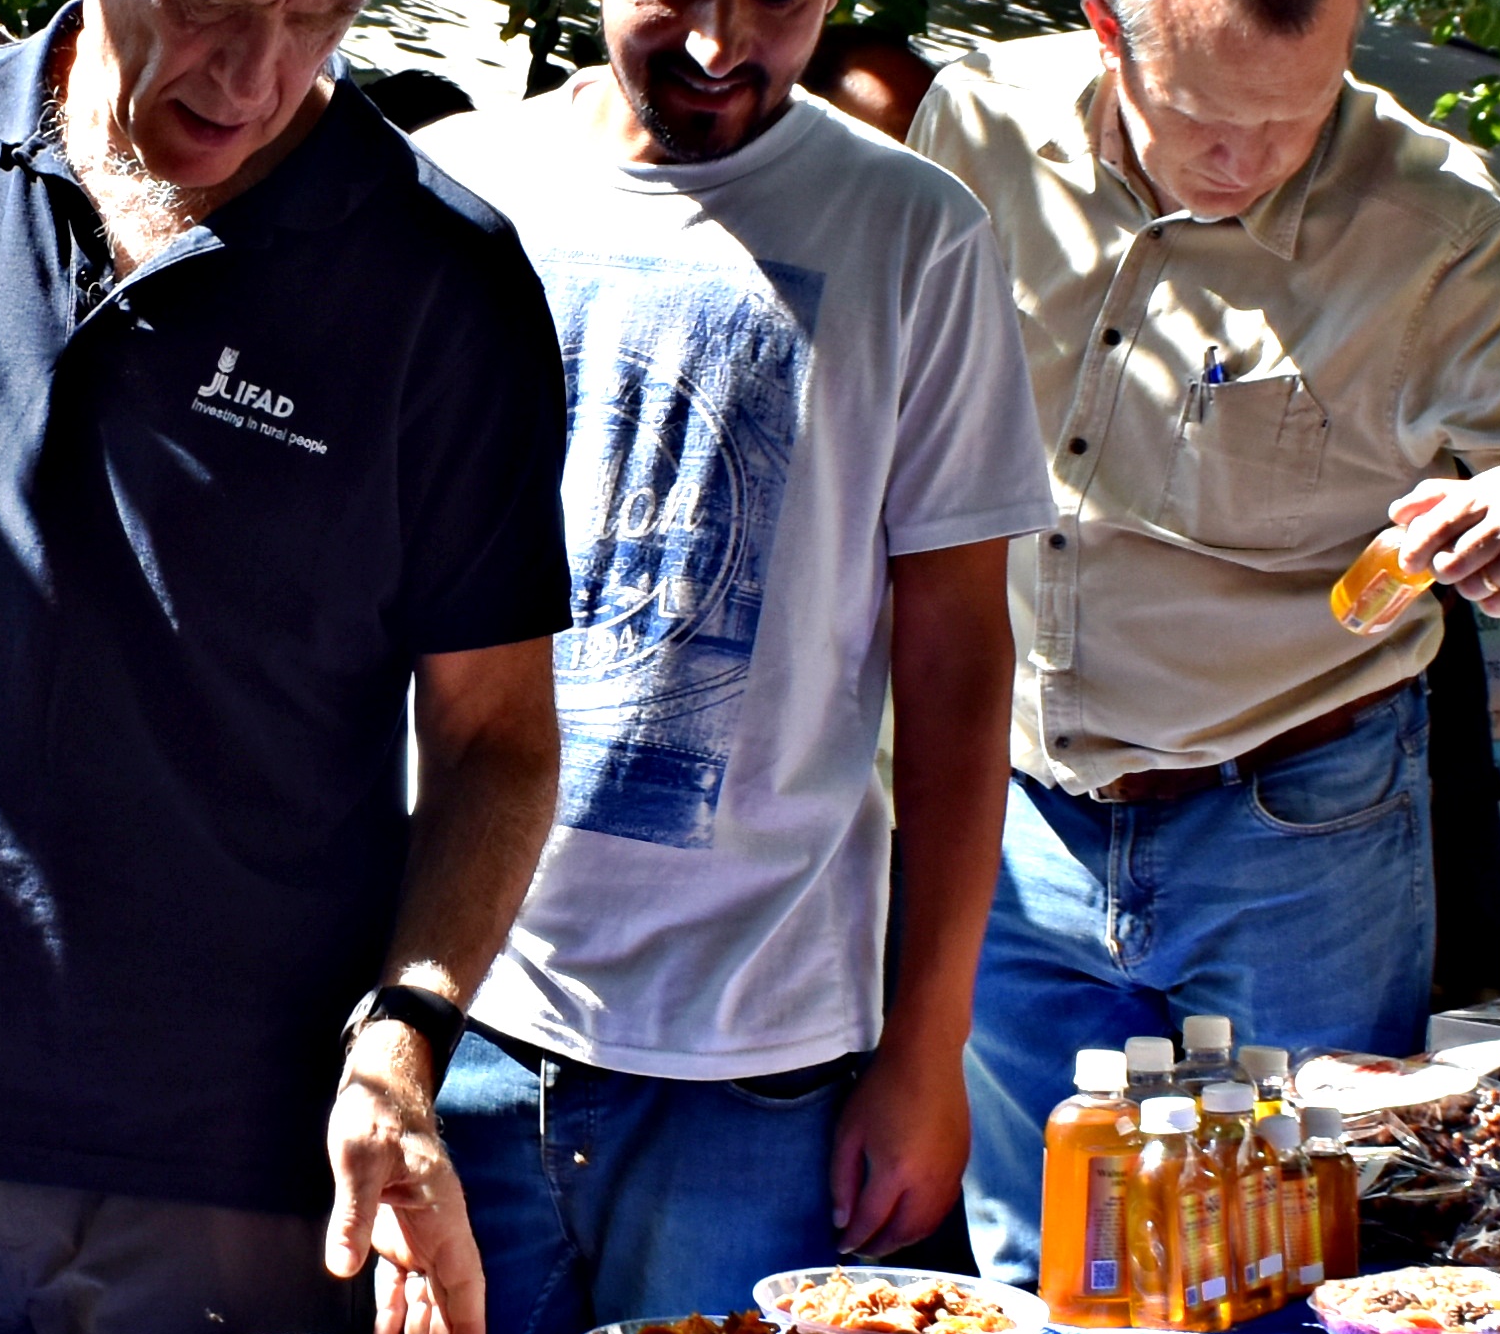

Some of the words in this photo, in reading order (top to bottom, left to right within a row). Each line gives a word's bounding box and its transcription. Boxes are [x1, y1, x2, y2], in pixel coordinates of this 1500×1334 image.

[233, 380, 294, 418] IFAD
[191, 397, 244, 428] Investing
[259, 421, 287, 441] rural
[288, 431, 328, 455] people
